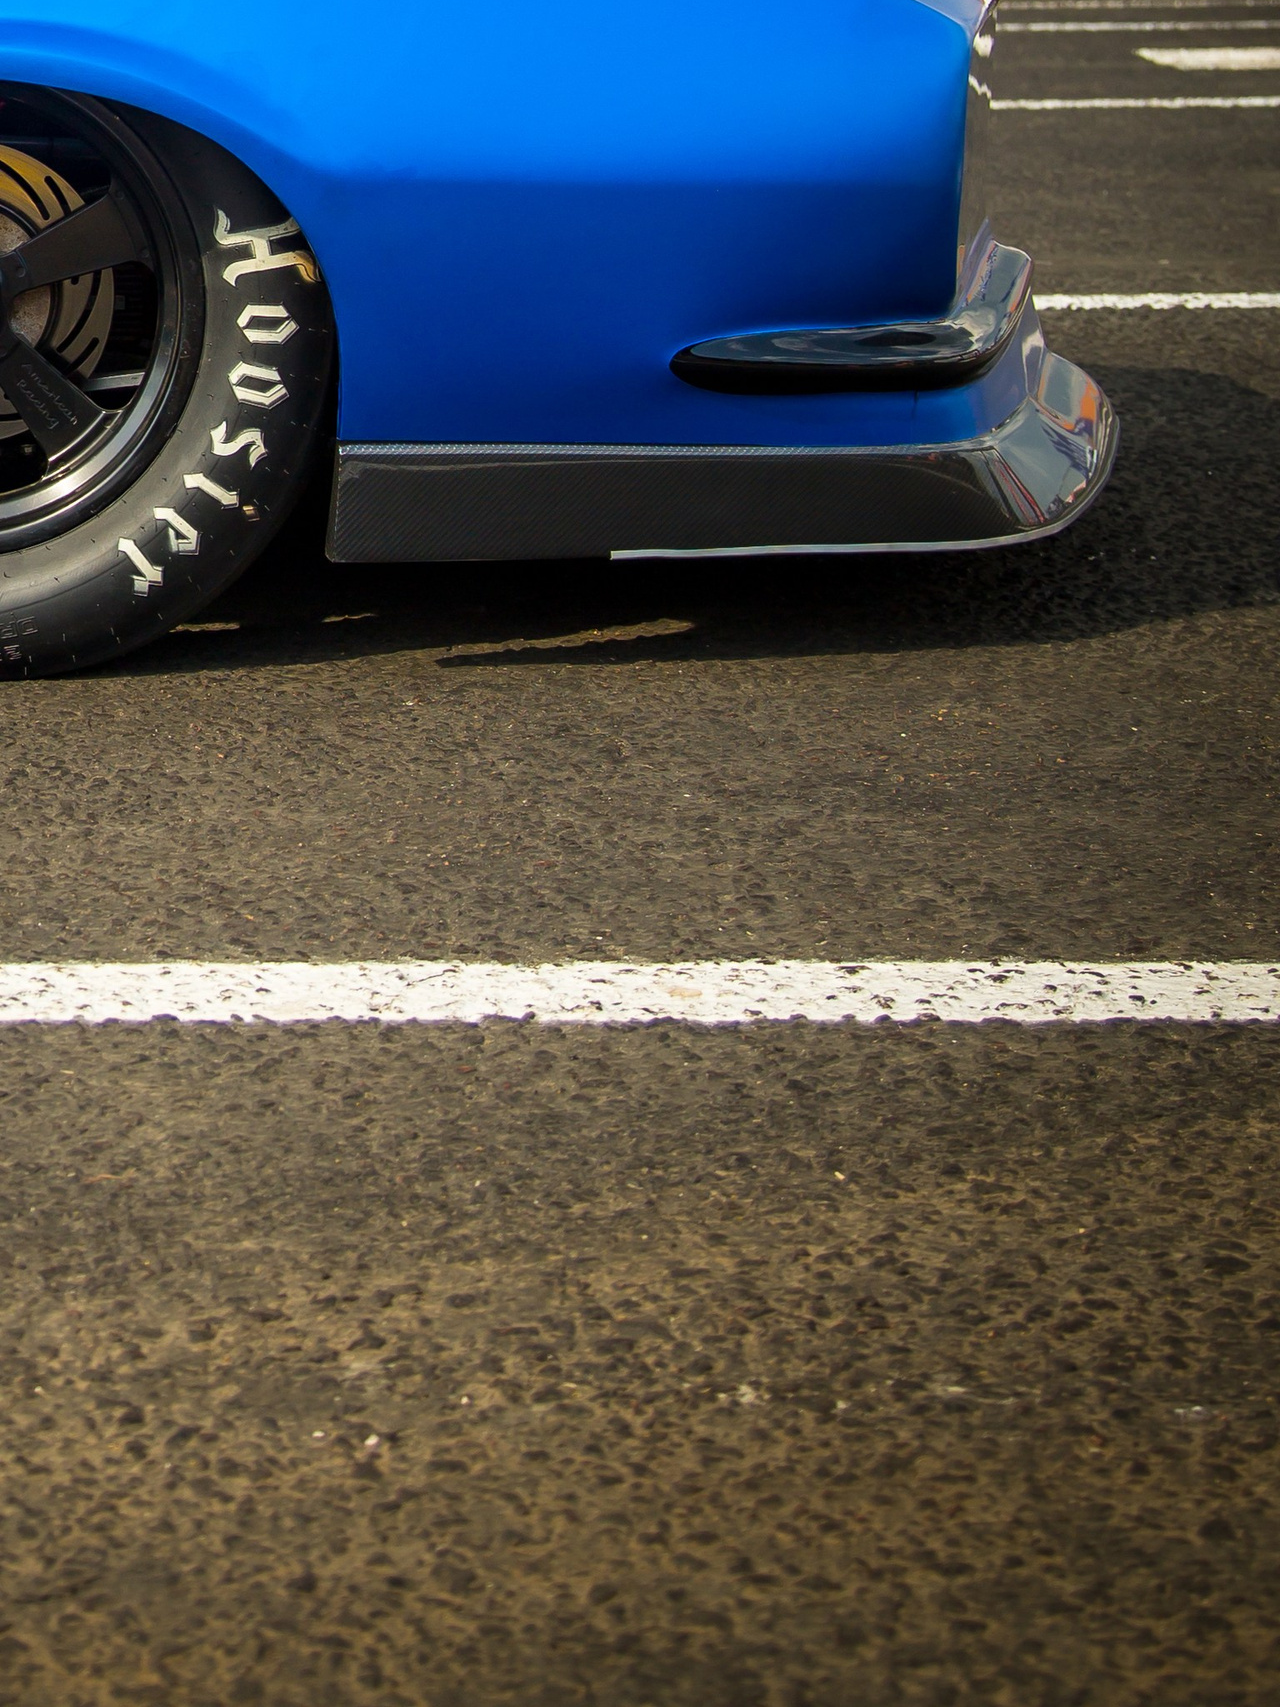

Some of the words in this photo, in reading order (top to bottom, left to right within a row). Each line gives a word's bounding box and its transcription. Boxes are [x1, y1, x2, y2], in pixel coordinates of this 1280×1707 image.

[16, 379, 60, 430] Racing
[20, 363, 78, 425] American
[117, 205, 322, 597] Hoosier
